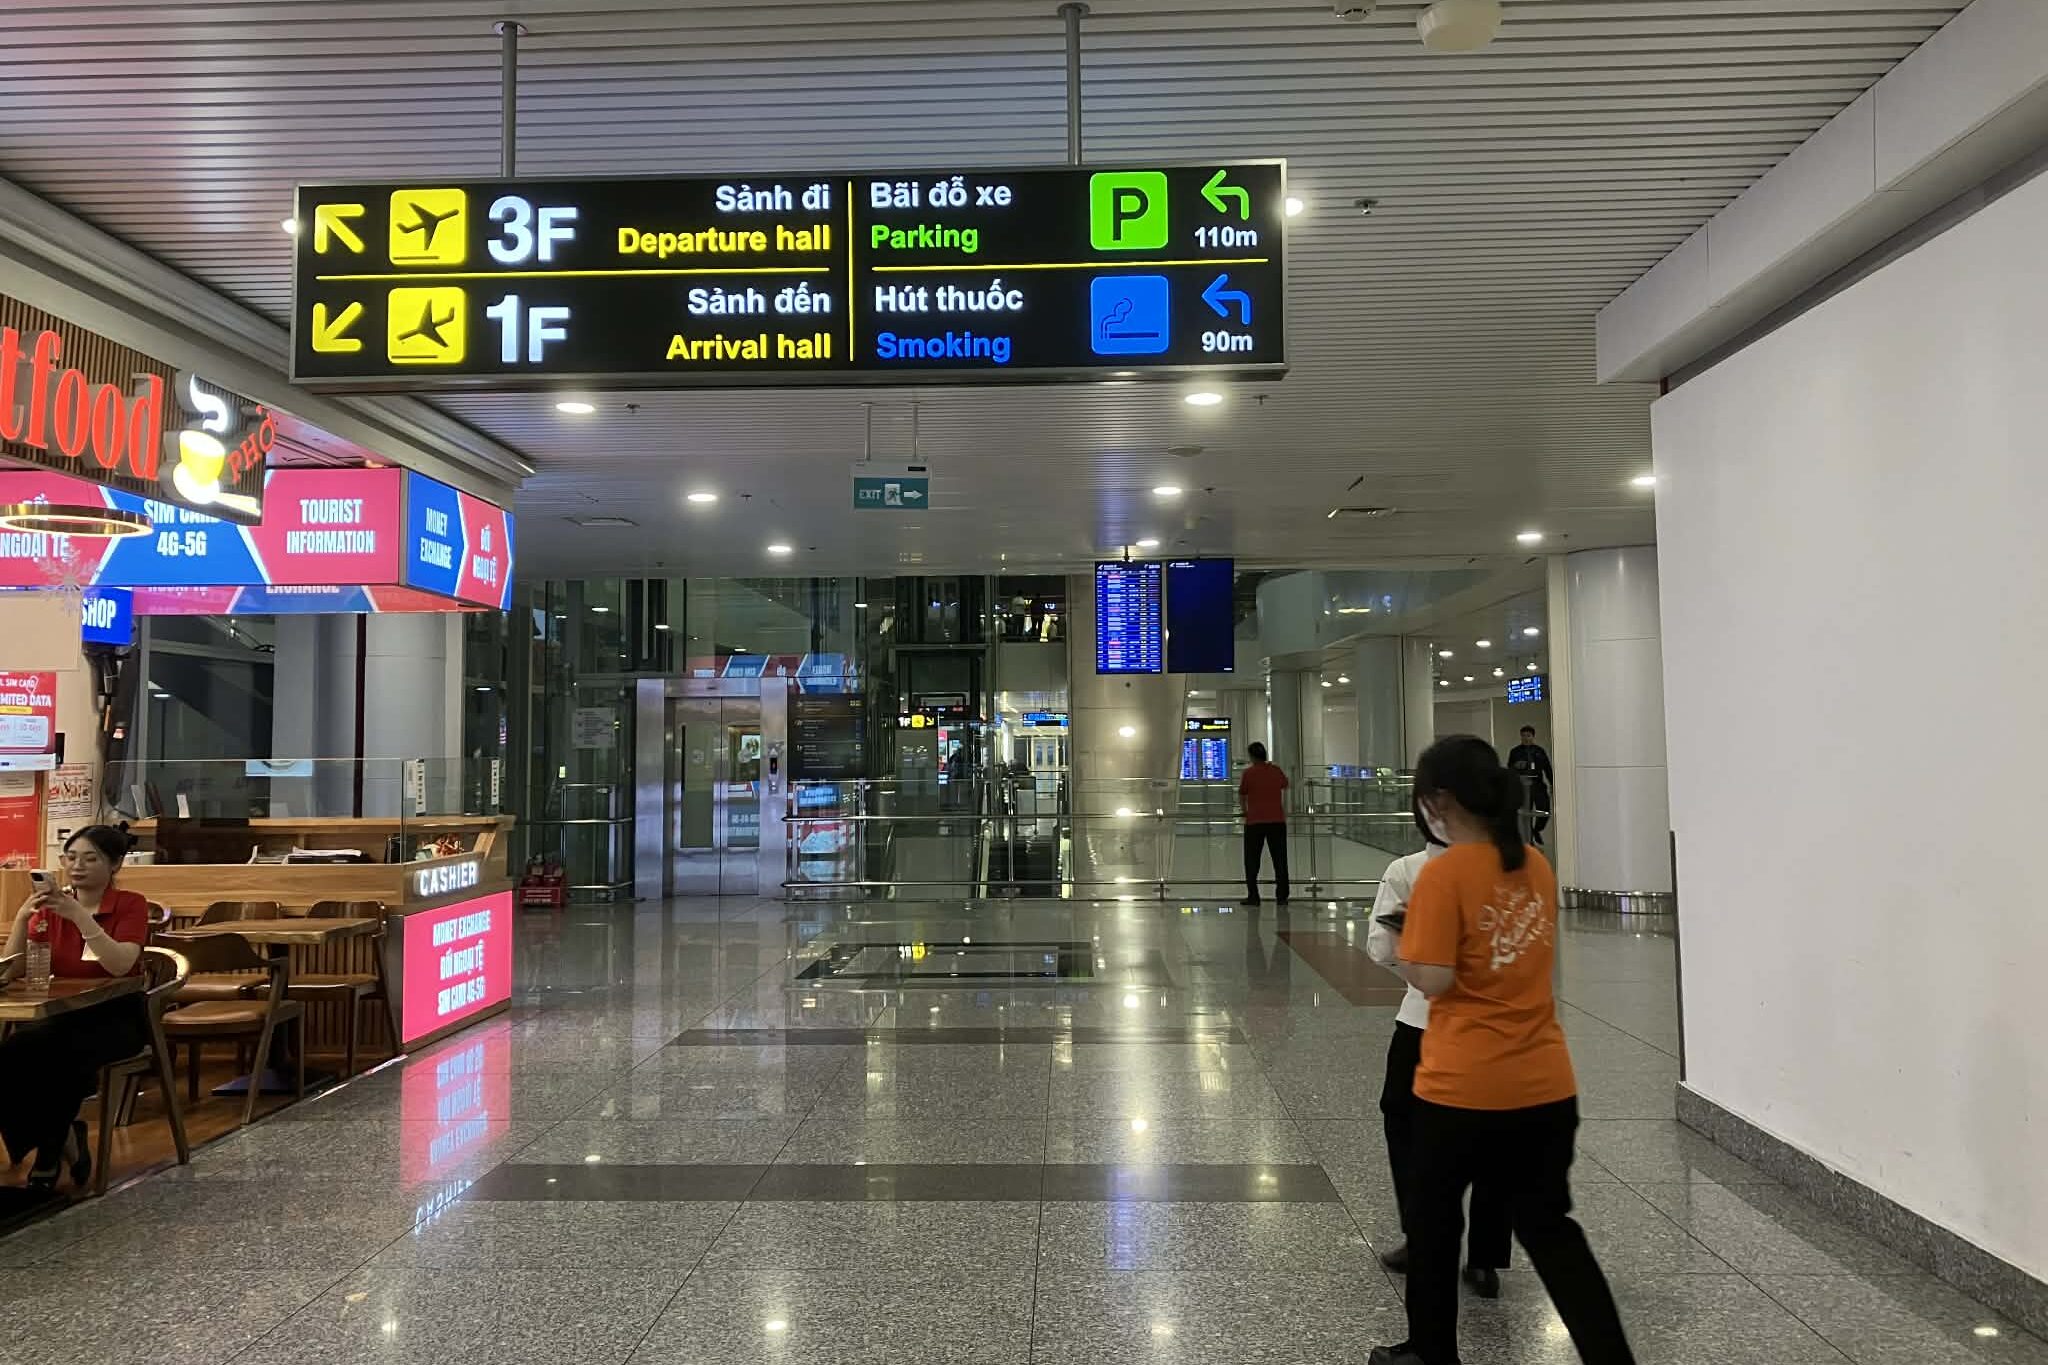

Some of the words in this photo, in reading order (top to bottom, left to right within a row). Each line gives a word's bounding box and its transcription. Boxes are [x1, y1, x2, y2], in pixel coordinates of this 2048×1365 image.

[715, 184, 787, 212] Sảnh
[795, 184, 831, 211] đi
[871, 181, 919, 208] Bãi
[928, 176, 968, 207] đỗ
[976, 185, 1012, 206] xe
[1112, 187, 1149, 241] P
[487, 196, 578, 264] 3F
[618, 226, 768, 258] Departure
[777, 225, 831, 251] hall
[871, 224, 978, 253] Parking
[1194, 226, 1258, 248] 110m
[687, 287, 767, 315] Sảnh
[774, 282, 831, 314] đến
[875, 286, 928, 312] Hút
[936, 279, 1024, 312] thuốc
[486, 294, 570, 363] 1F
[1201, 330, 1253, 352] 90m
[665, 334, 767, 360] Arrival
[777, 333, 831, 358] hall
[876, 331, 1012, 363] Smoking
[859, 489, 881, 500] EXIT
[144, 499, 175, 524] SIM
[300, 498, 363, 524] TOURIST
[157, 530, 207, 556] 4G-5G
[286, 530, 376, 554] INFORMATION
[418, 861, 478, 896] CASHIER
